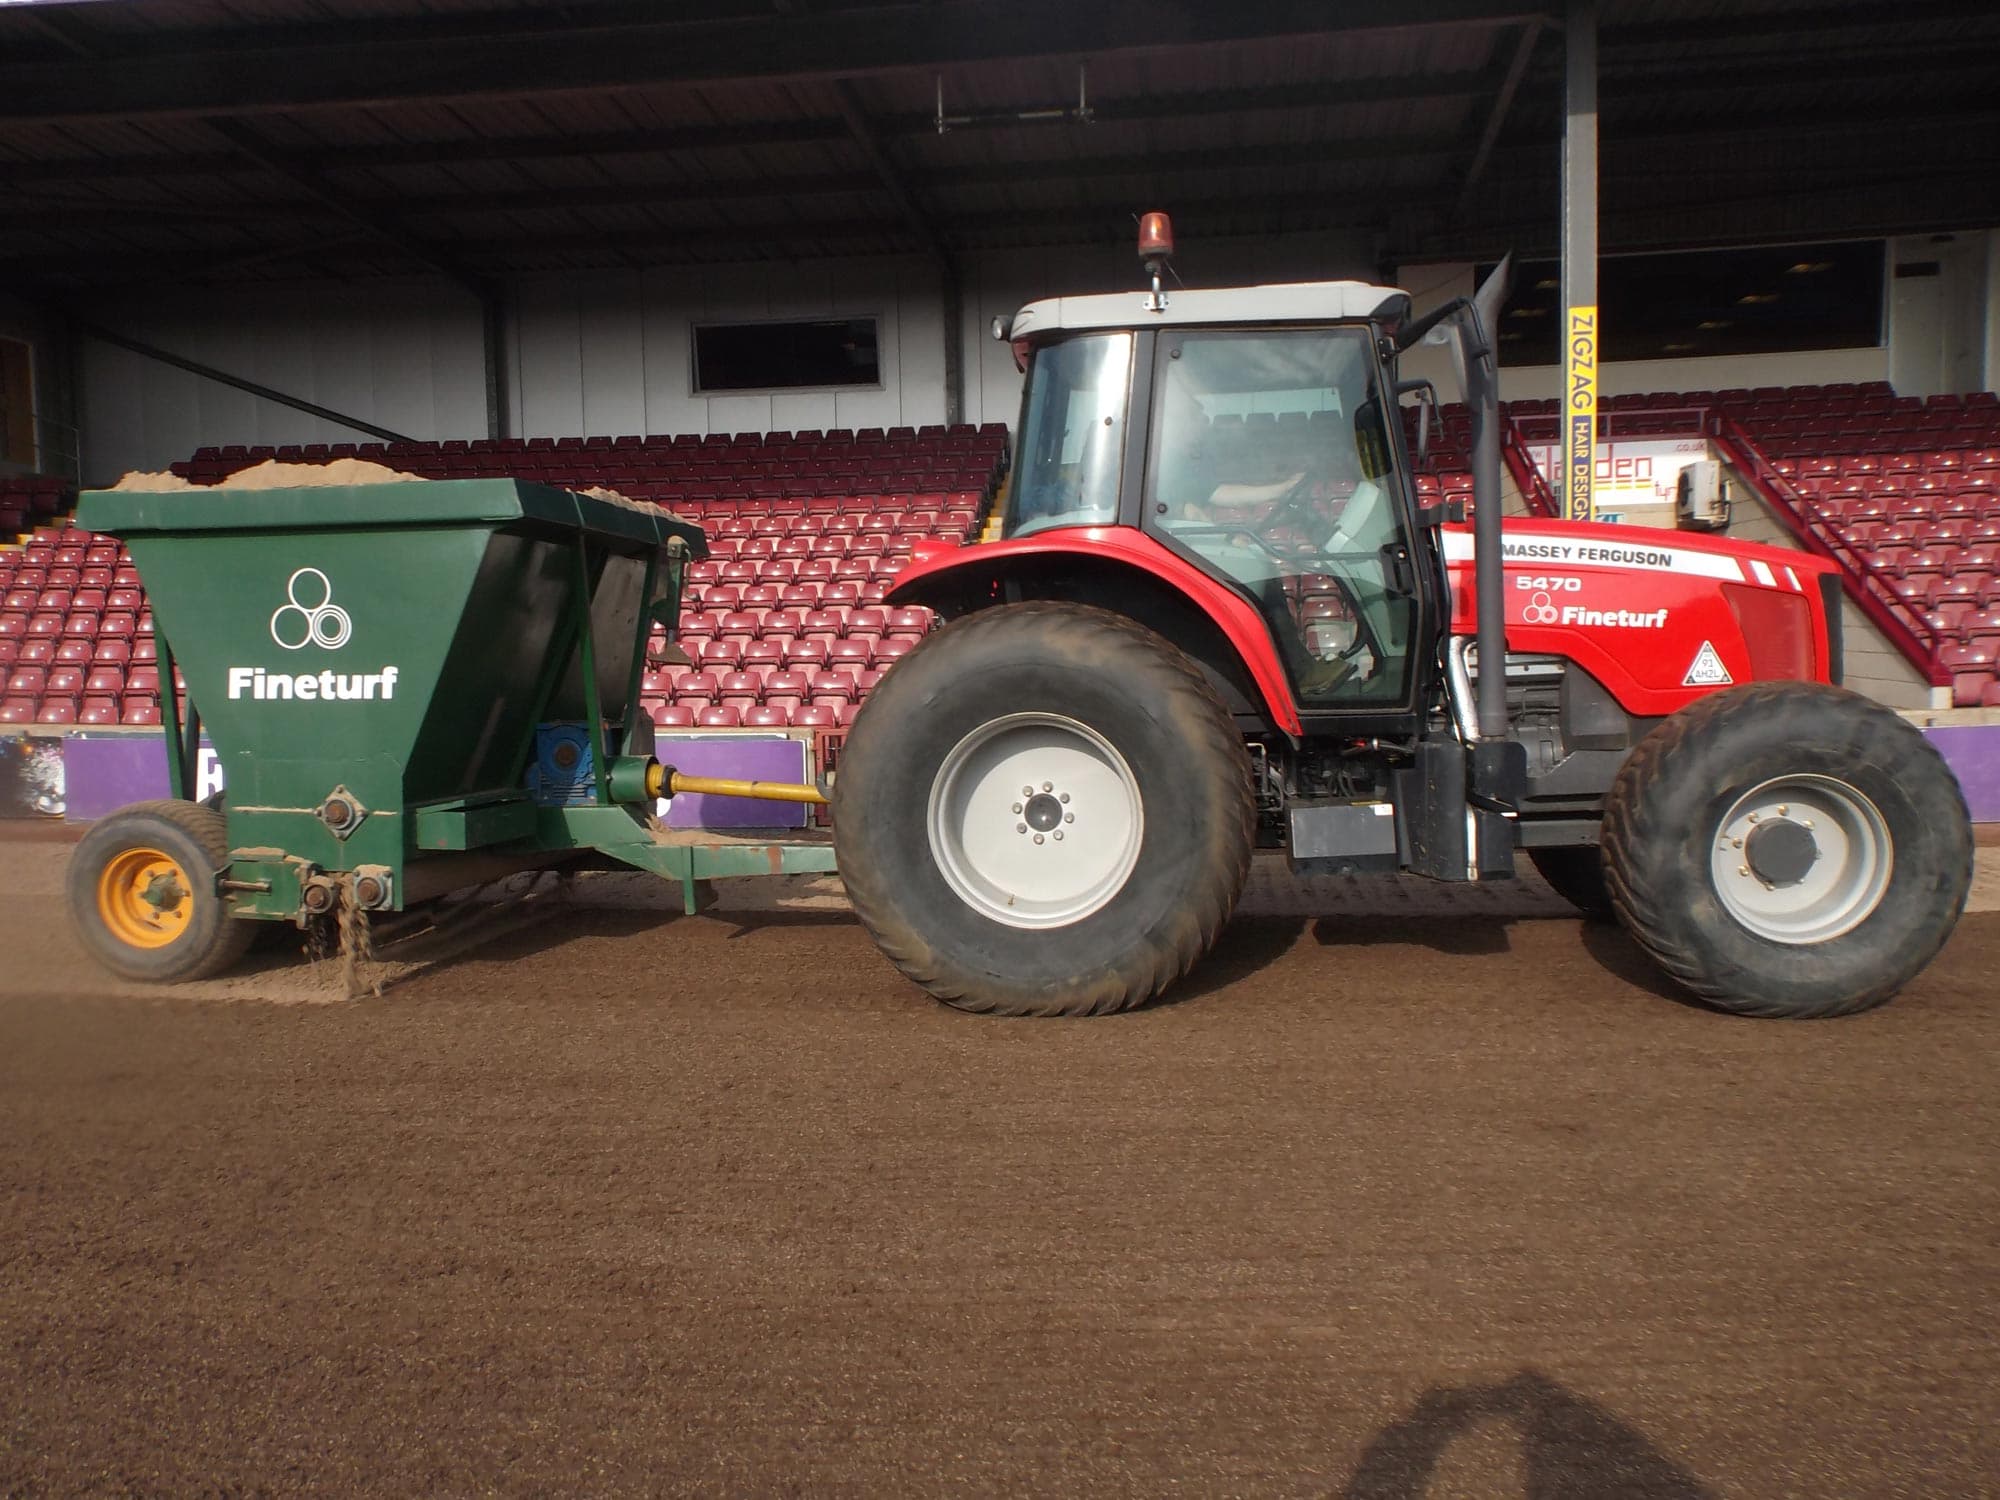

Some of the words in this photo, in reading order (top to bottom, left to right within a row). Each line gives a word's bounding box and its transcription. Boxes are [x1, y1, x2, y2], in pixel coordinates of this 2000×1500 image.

[1572, 314, 1593, 410] ZIGZAG
[1574, 422, 1590, 459] HAIR
[1501, 543, 1572, 559] MASSEY
[1578, 547, 1672, 567] FERGUSON
[1516, 576, 1582, 591] 5470
[1562, 606, 1669, 628] Fineturf
[228, 666, 399, 700] Fineturf
